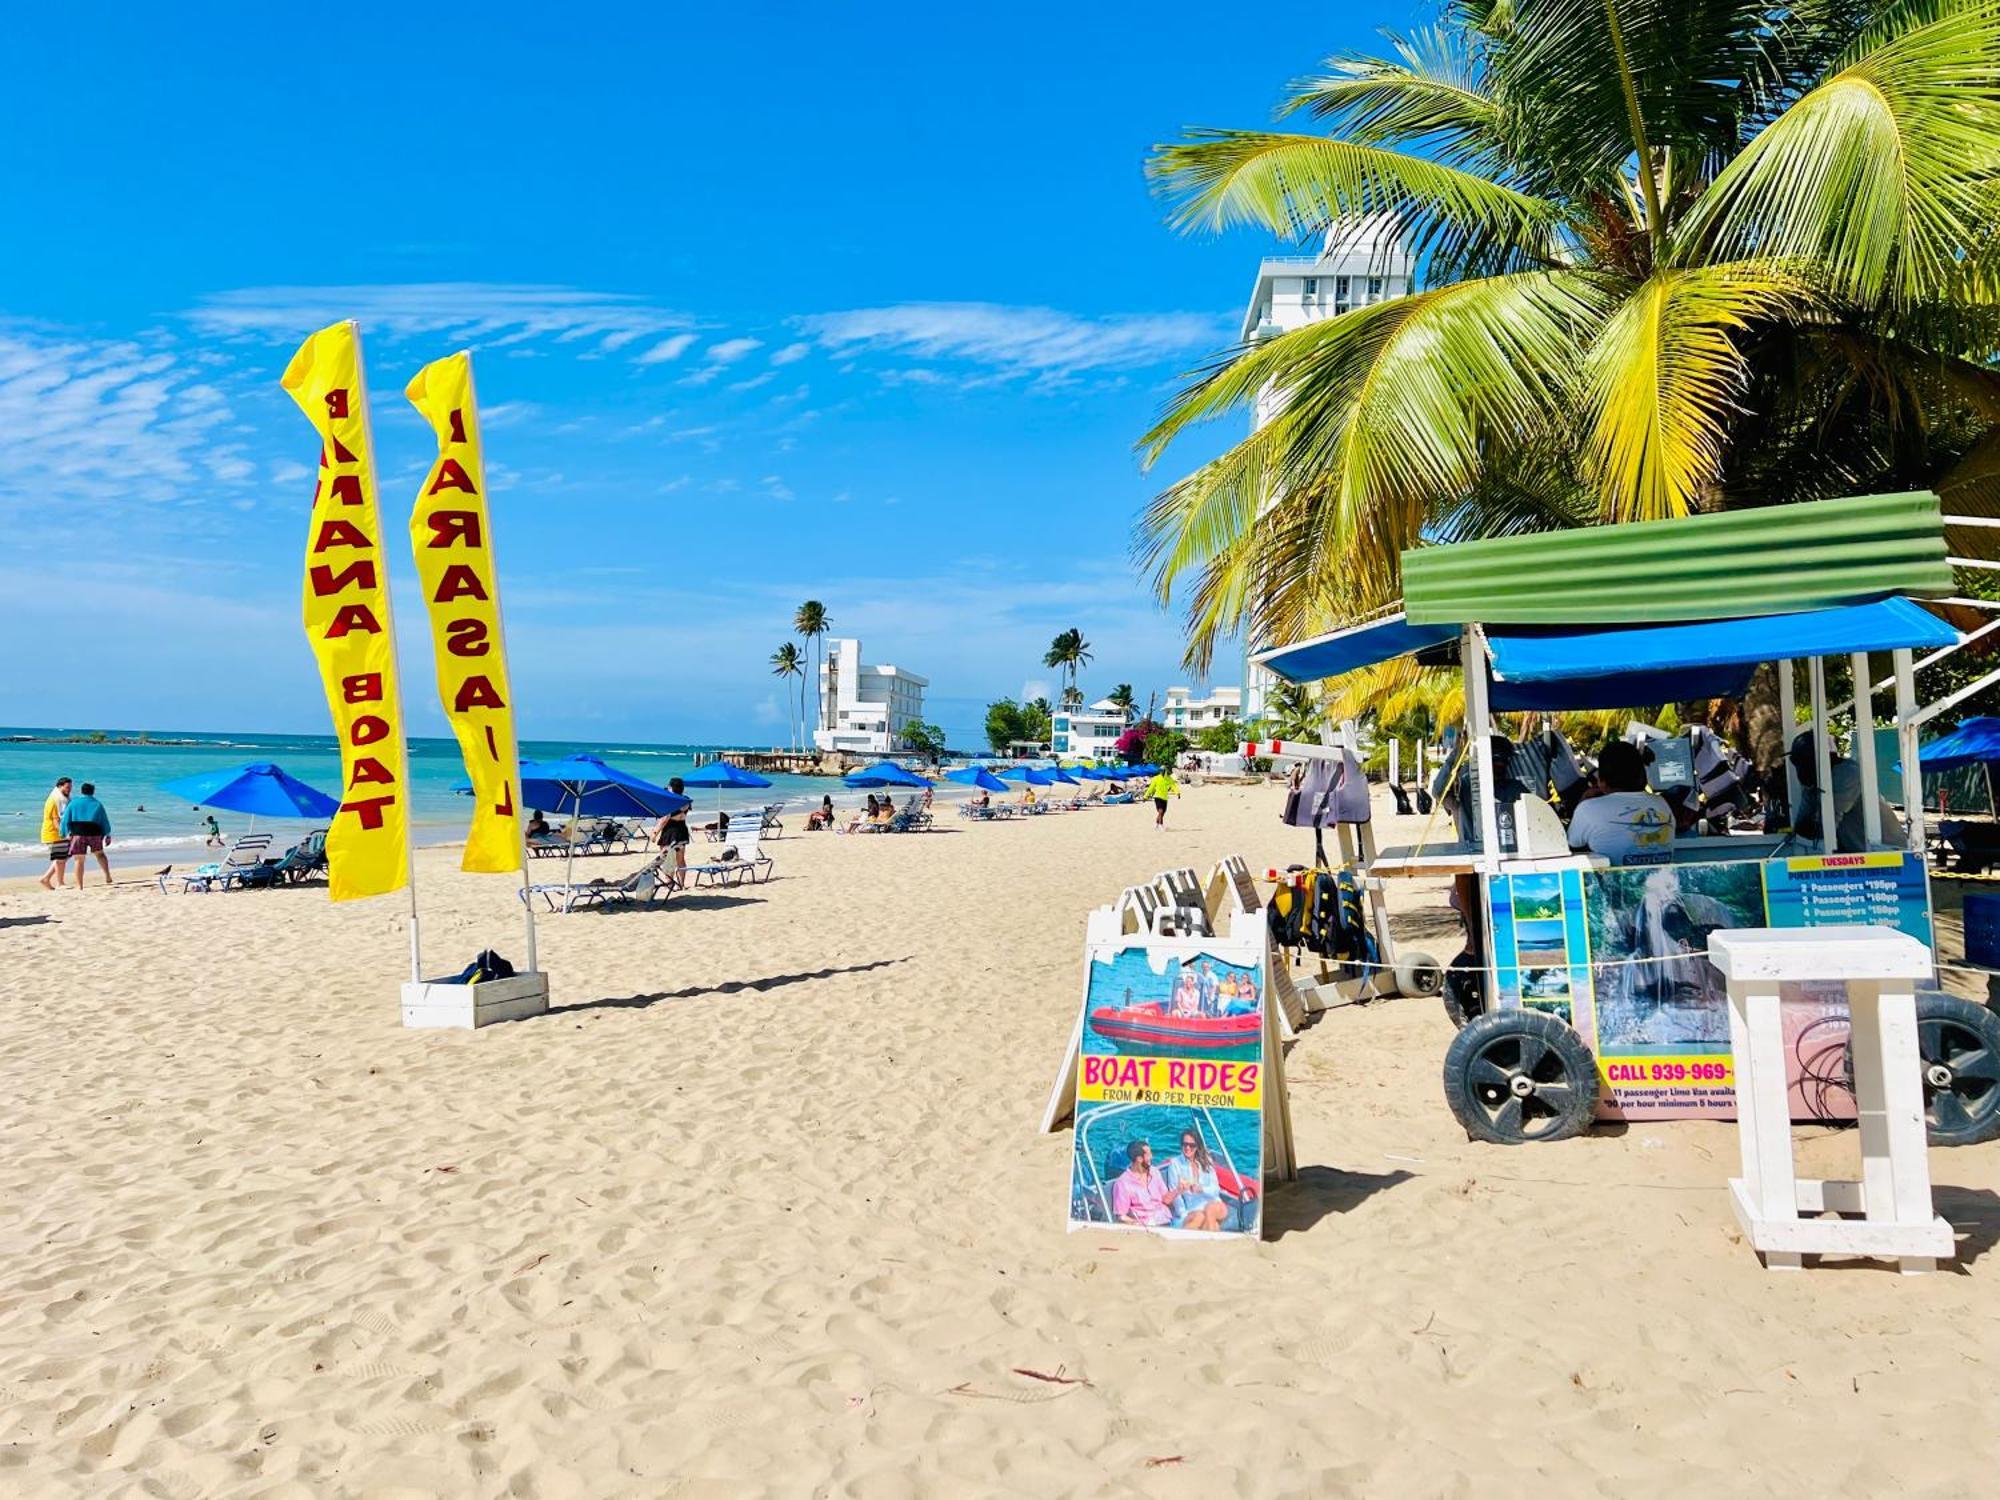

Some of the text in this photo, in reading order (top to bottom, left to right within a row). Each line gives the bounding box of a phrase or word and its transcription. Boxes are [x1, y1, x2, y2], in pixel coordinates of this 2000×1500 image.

[1821, 856, 1865, 867] TUESDAYS
[1801, 884, 1807, 893] 2
[1811, 883, 1864, 893] Passengers
[1802, 896, 1808, 905] 3
[1813, 895, 1865, 906] Passengers
[1803, 908, 1810, 917] 4
[1814, 907, 1866, 918] Passengers
[1085, 1056, 1258, 1094] BOAT RIDES
[1608, 1063, 1735, 1081] CALL 939-969-
[1103, 1088, 1132, 1101] FROM
[1164, 1092, 1184, 1104] PER
[1190, 1093, 1235, 1106] PERSON
[1624, 1089, 1667, 1099] passenger
[1670, 1087, 1690, 1096] Limo
[1692, 1087, 1708, 1096] Van
[1620, 1101, 1634, 1109] per
[1637, 1100, 1655, 1108] hour
[1658, 1099, 1698, 1107] minimum
[1708, 1099, 1732, 1107] hours
